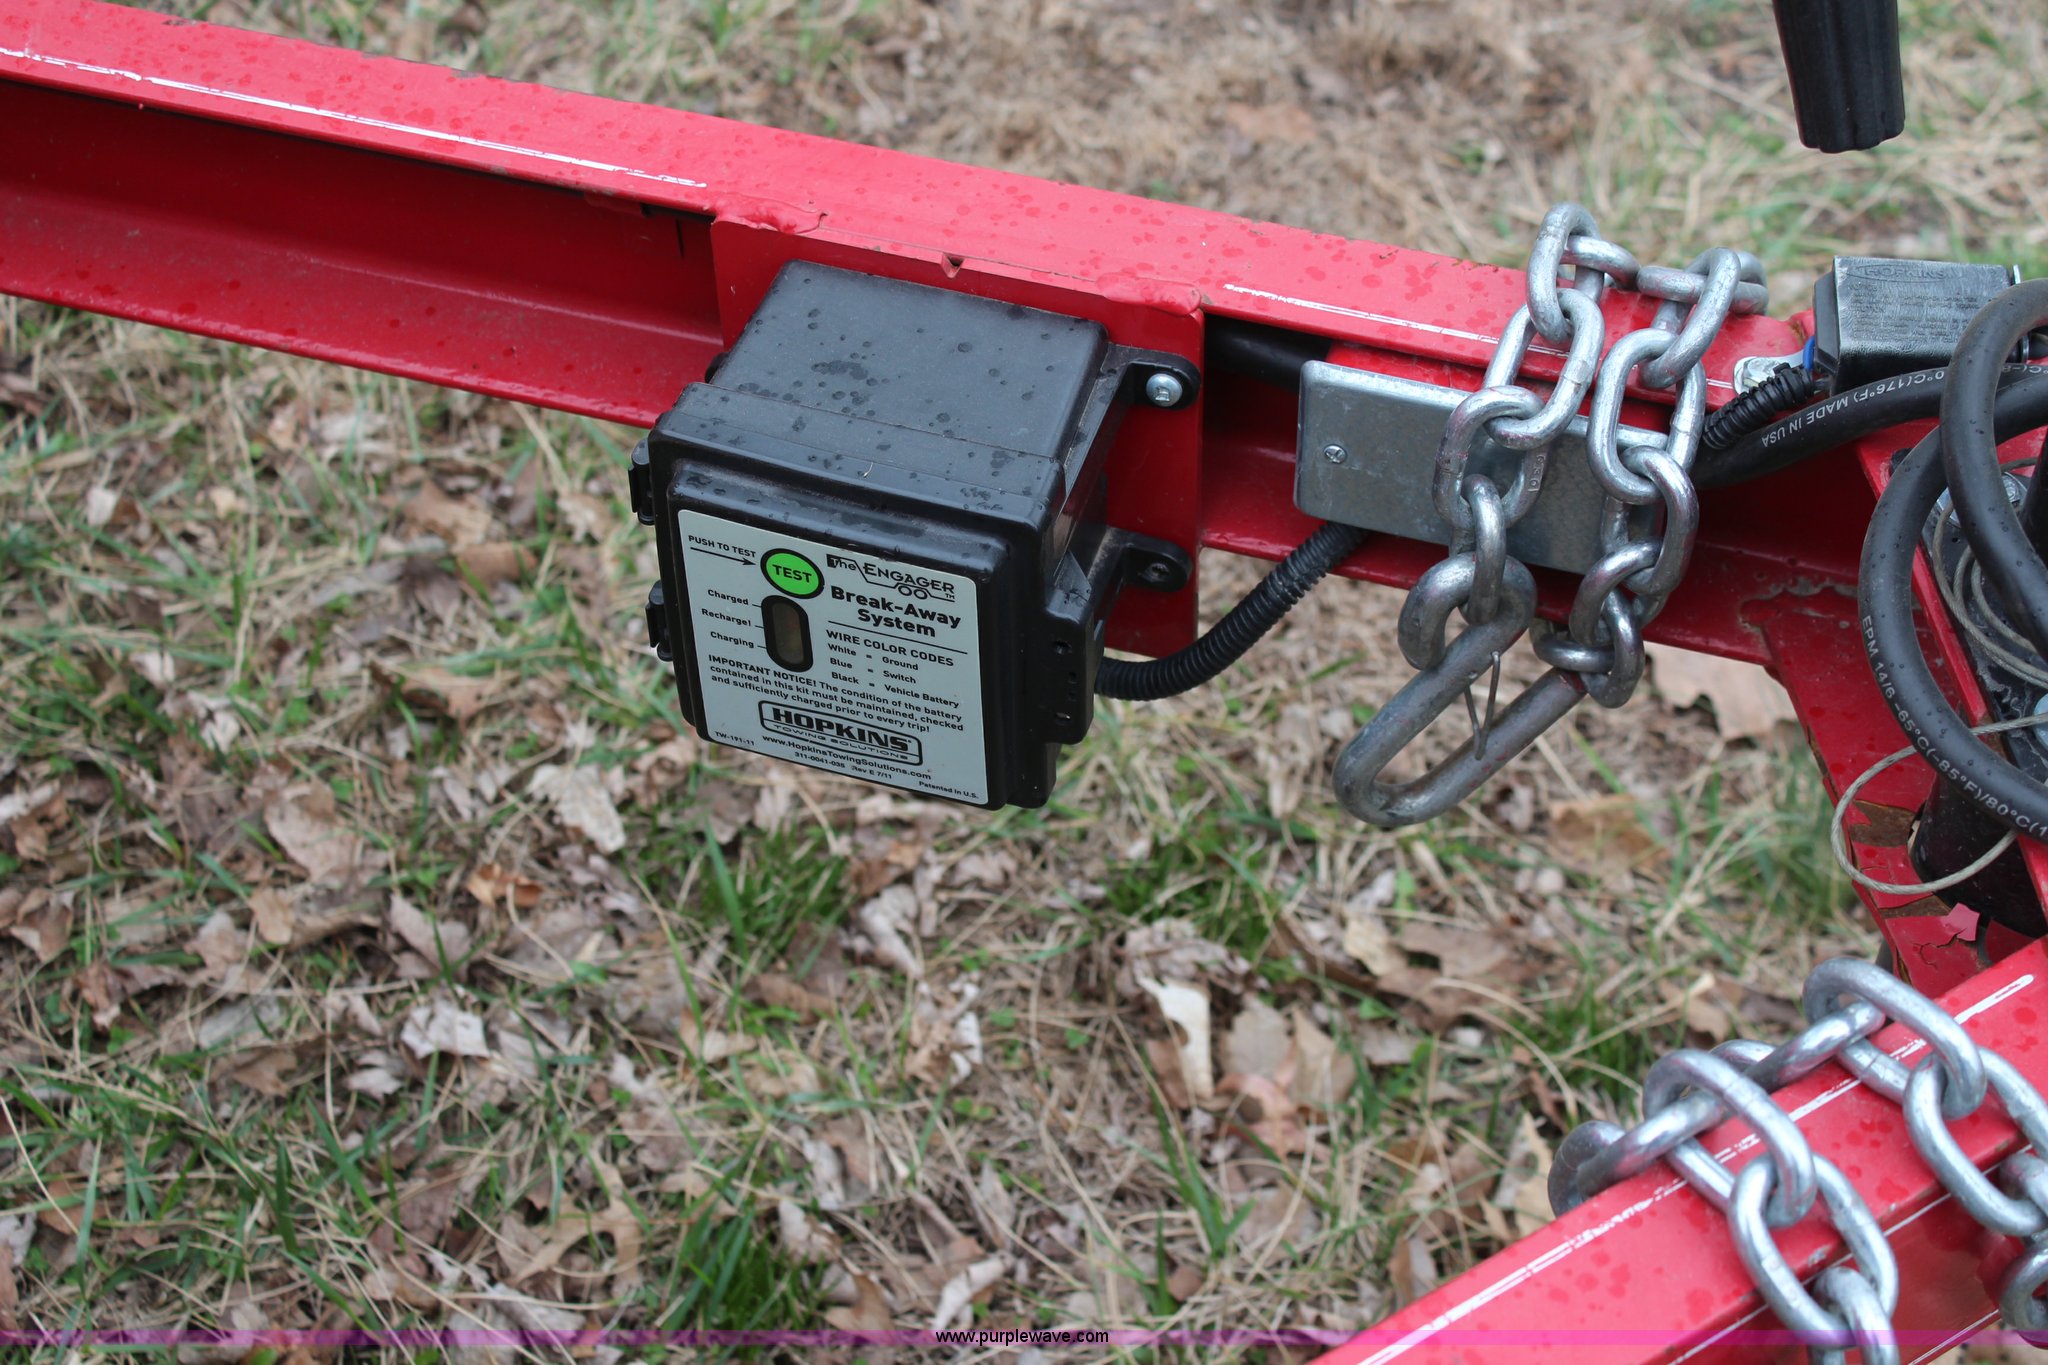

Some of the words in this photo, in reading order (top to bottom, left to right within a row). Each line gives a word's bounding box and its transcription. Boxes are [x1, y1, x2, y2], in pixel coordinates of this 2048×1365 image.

[1789, 417, 1802, 433] IN
[1806, 396, 1848, 425] MADE
[1761, 428, 1786, 448] USA
[688, 535, 715, 548] PUSH
[717, 542, 730, 551] TO
[732, 546, 756, 558] TEST
[772, 564, 812, 583] TEST
[830, 558, 857, 571] The
[863, 562, 955, 594] ENGAGER
[708, 589, 749, 605] Charged
[831, 585, 961, 629] Break-Away
[857, 608, 936, 637] System
[710, 631, 754, 648] Charging
[826, 629, 860, 645] WIRE
[864, 639, 907, 656] COLOR
[911, 649, 954, 667] CODES
[828, 643, 857, 656] White
[882, 656, 919, 671] Ground
[830, 657, 853, 669] Blue
[883, 670, 916, 684] Switch
[1862, 615, 1879, 658] EPM
[1875, 661, 1896, 699] 14/6
[709, 654, 770, 675] IMPORTANT
[774, 671, 816, 687] NOTICE!
[819, 681, 839, 692] The
[841, 688, 889, 705] condition
[892, 700, 902, 708] of
[904, 702, 921, 712] the
[924, 706, 962, 722] battery
[710, 665, 760, 682] contained
[762, 677, 772, 685] in
[774, 680, 794, 691] this
[796, 685, 809, 695] kit
[812, 690, 838, 702] must
[841, 696, 853, 706] be
[920, 716, 964, 731] checked
[711, 675, 730, 685] and
[733, 680, 789, 700] sufficiently
[791, 694, 833, 710] charged
[835, 702, 861, 716] prior
[863, 711, 874, 720] to
[876, 715, 905, 728] every
[907, 721, 930, 733] trip!
[831, 672, 859, 684] Black
[884, 684, 920, 699] Vehicle
[922, 693, 960, 709] Battery
[772, 707, 909, 752] HOPKINS
[773, 724, 826, 741] TOWING
[830, 739, 909, 760] SOLUTIONS
[762, 735, 932, 780] www.HopkinsTowingSolutions.com
[919, 781, 953, 793] Patented
[954, 787, 962, 795] in
